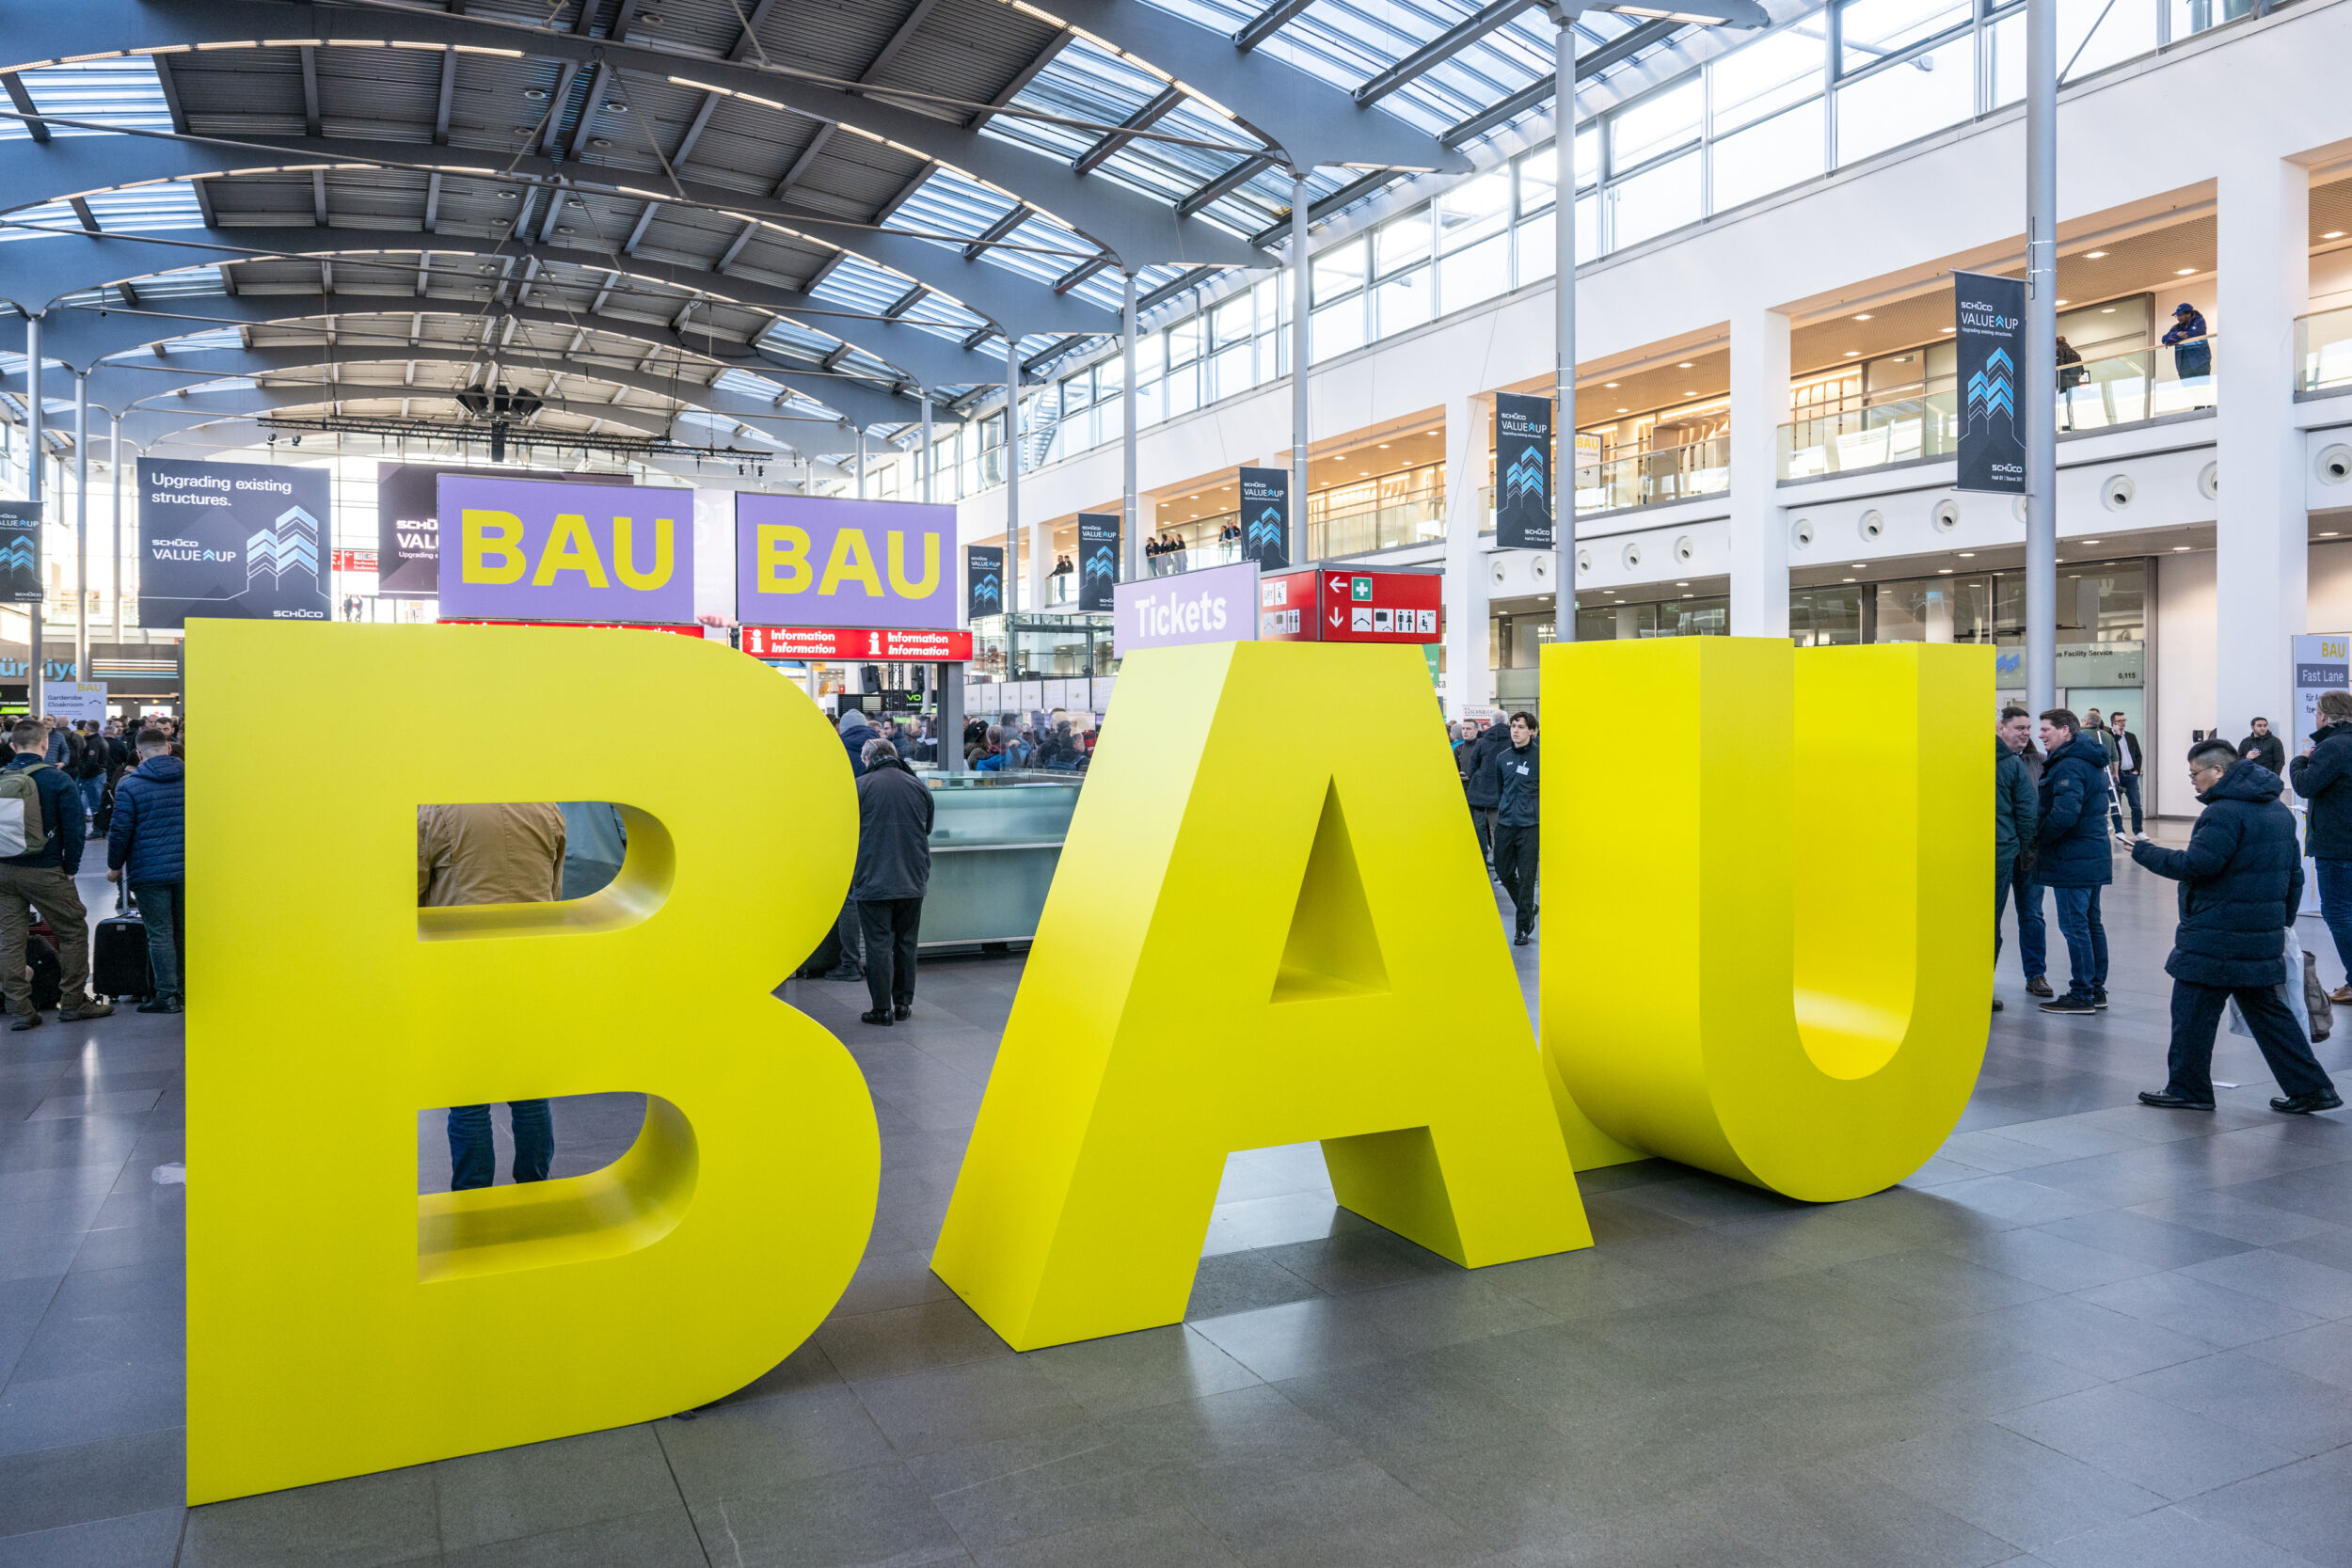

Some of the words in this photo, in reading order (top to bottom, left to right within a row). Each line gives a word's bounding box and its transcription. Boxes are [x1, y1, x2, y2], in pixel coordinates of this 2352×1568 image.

[1961, 311, 1995, 327] VALUE
[2004, 317, 2019, 330] UP
[1502, 420, 1529, 432] VALUE
[1535, 424, 1548, 434] UP
[1576, 436, 1599, 450] BAU
[151, 472, 230, 492] Upgrading
[235, 479, 292, 495] existing
[151, 492, 231, 506] structures.
[1244, 488, 1267, 497] VALUE
[396, 518, 438, 531] SCHÜ
[151, 539, 199, 547] SCHÜCO
[396, 532, 438, 549] VAL
[151, 548, 202, 562] VALUE
[215, 551, 237, 562] UP
[398, 551, 434, 560] Upgrading
[462, 509, 675, 591] BAU
[757, 524, 940, 599] BAU
[273, 609, 324, 618] SCHÜCO
[1135, 591, 1228, 639] Tickets
[771, 629, 835, 641] Information
[887, 632, 948, 643] Information
[771, 642, 835, 654] Information
[888, 644, 949, 656] Information
[2322, 642, 2345, 657] BAU
[2302, 669, 2321, 682] Fast
[2323, 669, 2344, 682] Lane
[77, 683, 103, 692] BAU
[185, 616, 1995, 1506] BAU
